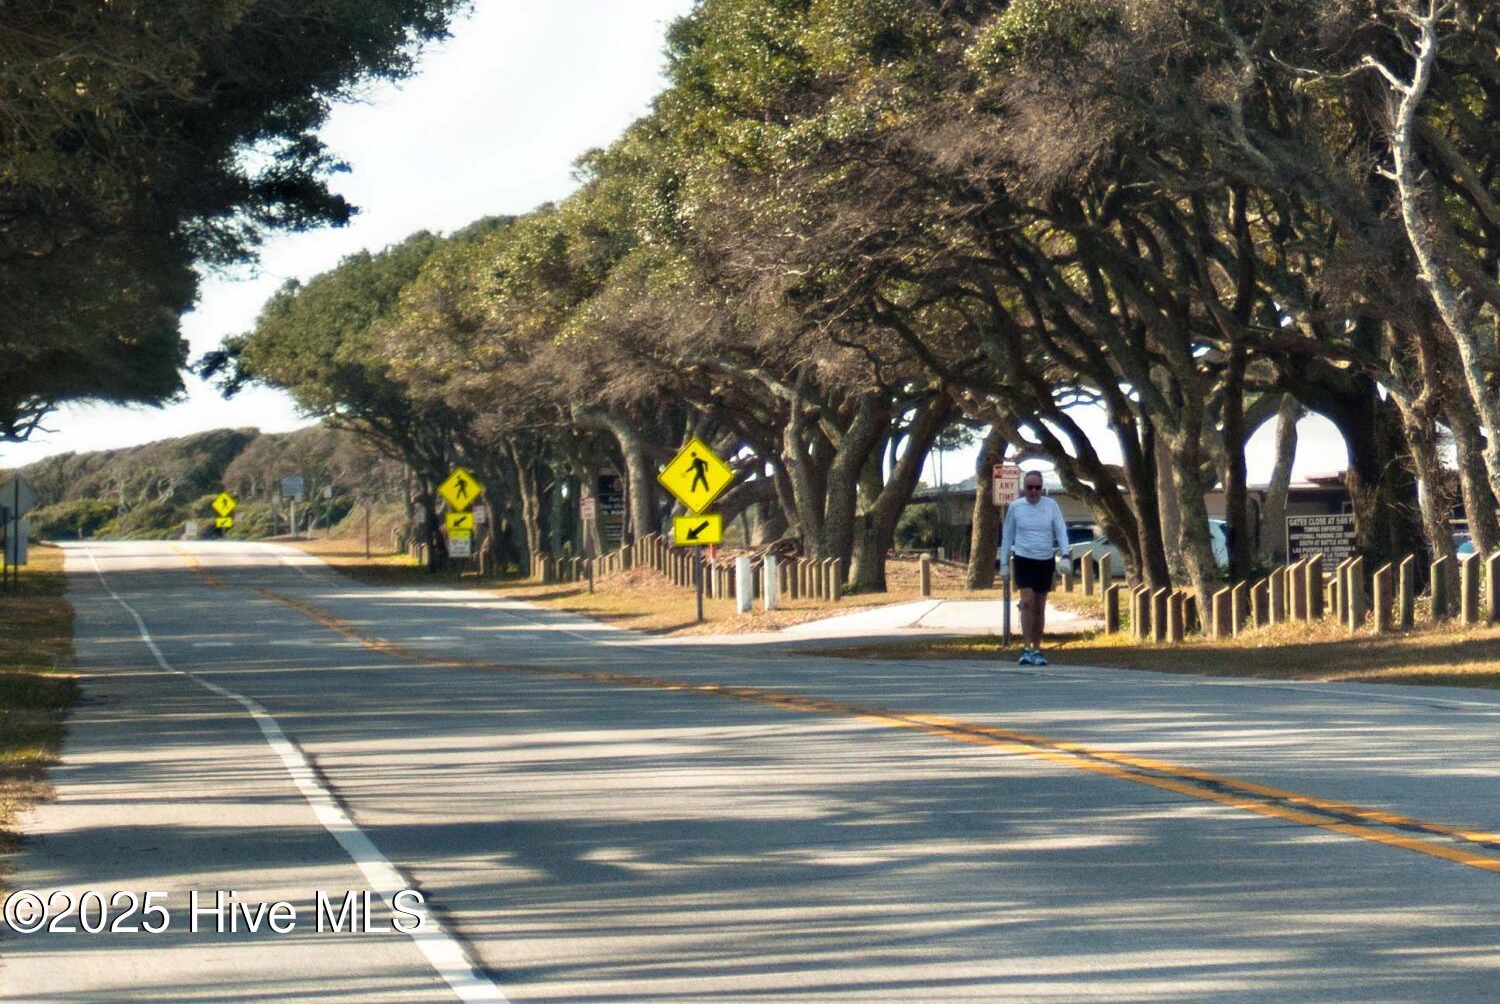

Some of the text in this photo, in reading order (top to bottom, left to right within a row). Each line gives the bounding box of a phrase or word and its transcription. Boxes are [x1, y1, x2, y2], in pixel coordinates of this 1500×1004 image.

[998, 492, 1015, 501] TIME
[1289, 518, 1308, 526] GATES
[1308, 517, 1326, 526] CLOSE
[1327, 517, 1335, 525] AT
